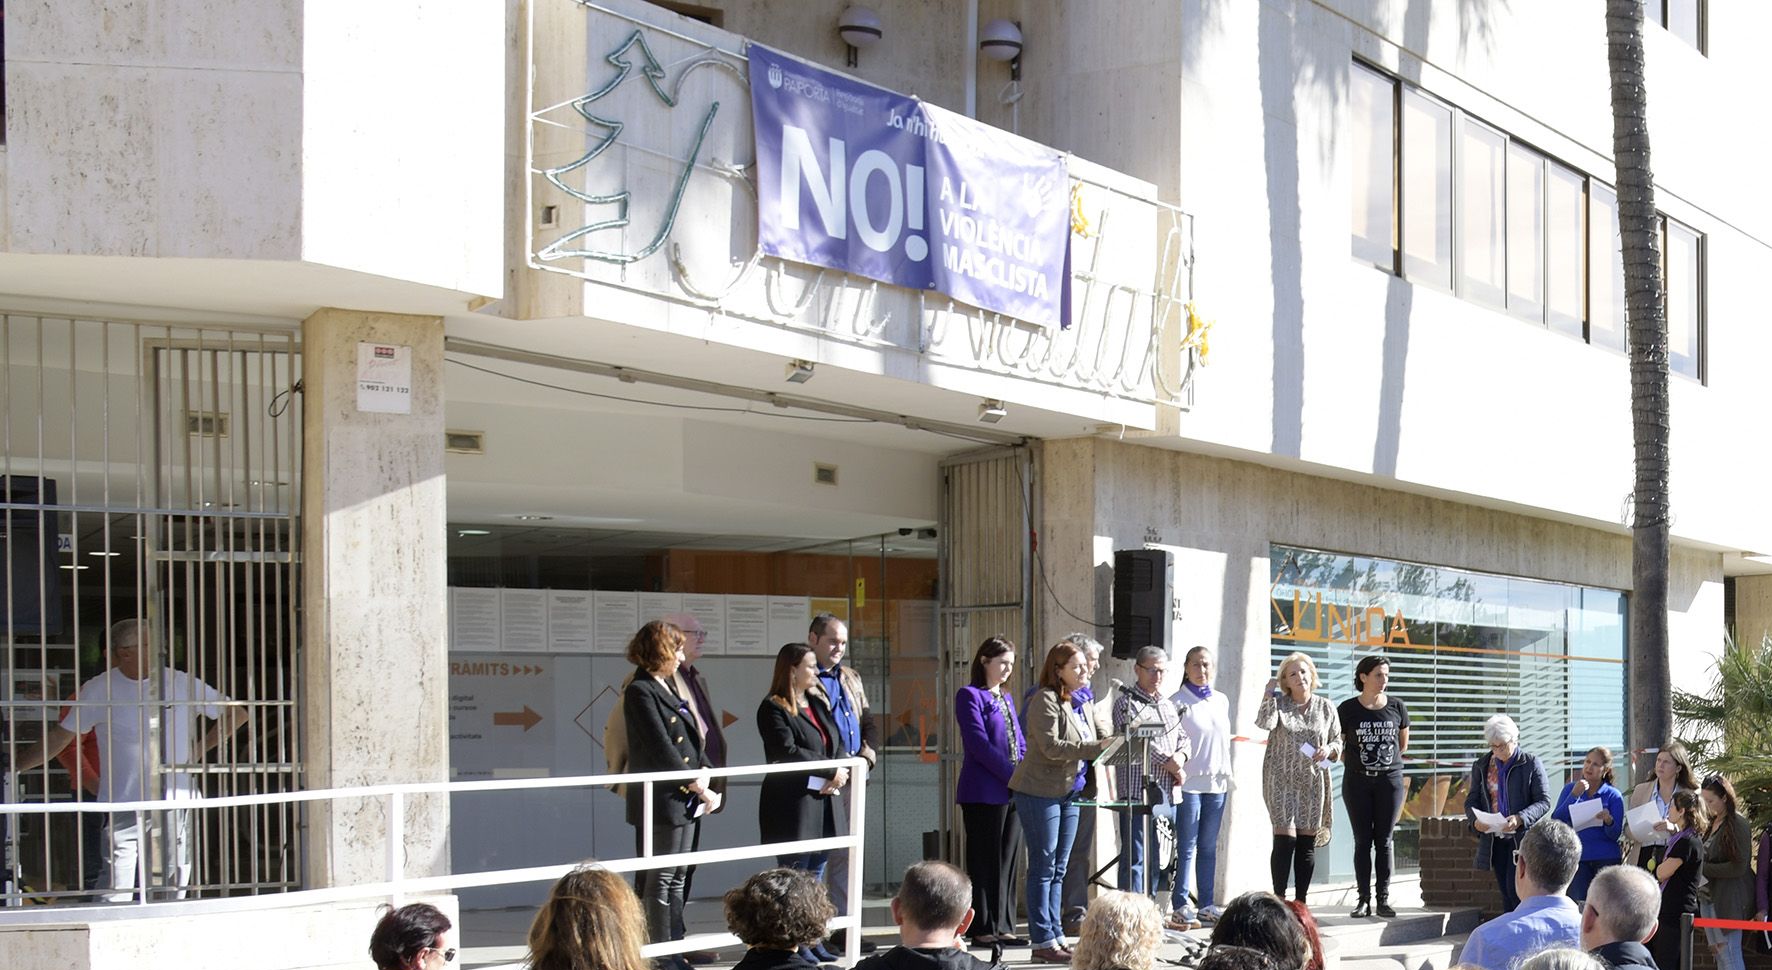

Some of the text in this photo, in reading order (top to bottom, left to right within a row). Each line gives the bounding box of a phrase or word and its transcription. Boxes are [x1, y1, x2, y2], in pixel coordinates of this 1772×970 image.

[886, 108, 903, 129] Ja
[906, 116, 928, 137] n'hi
[780, 124, 929, 263] NO!
[940, 176, 954, 204] A
[942, 242, 1049, 301] MASCLISTA
[449, 660, 509, 676] RÀMITS
